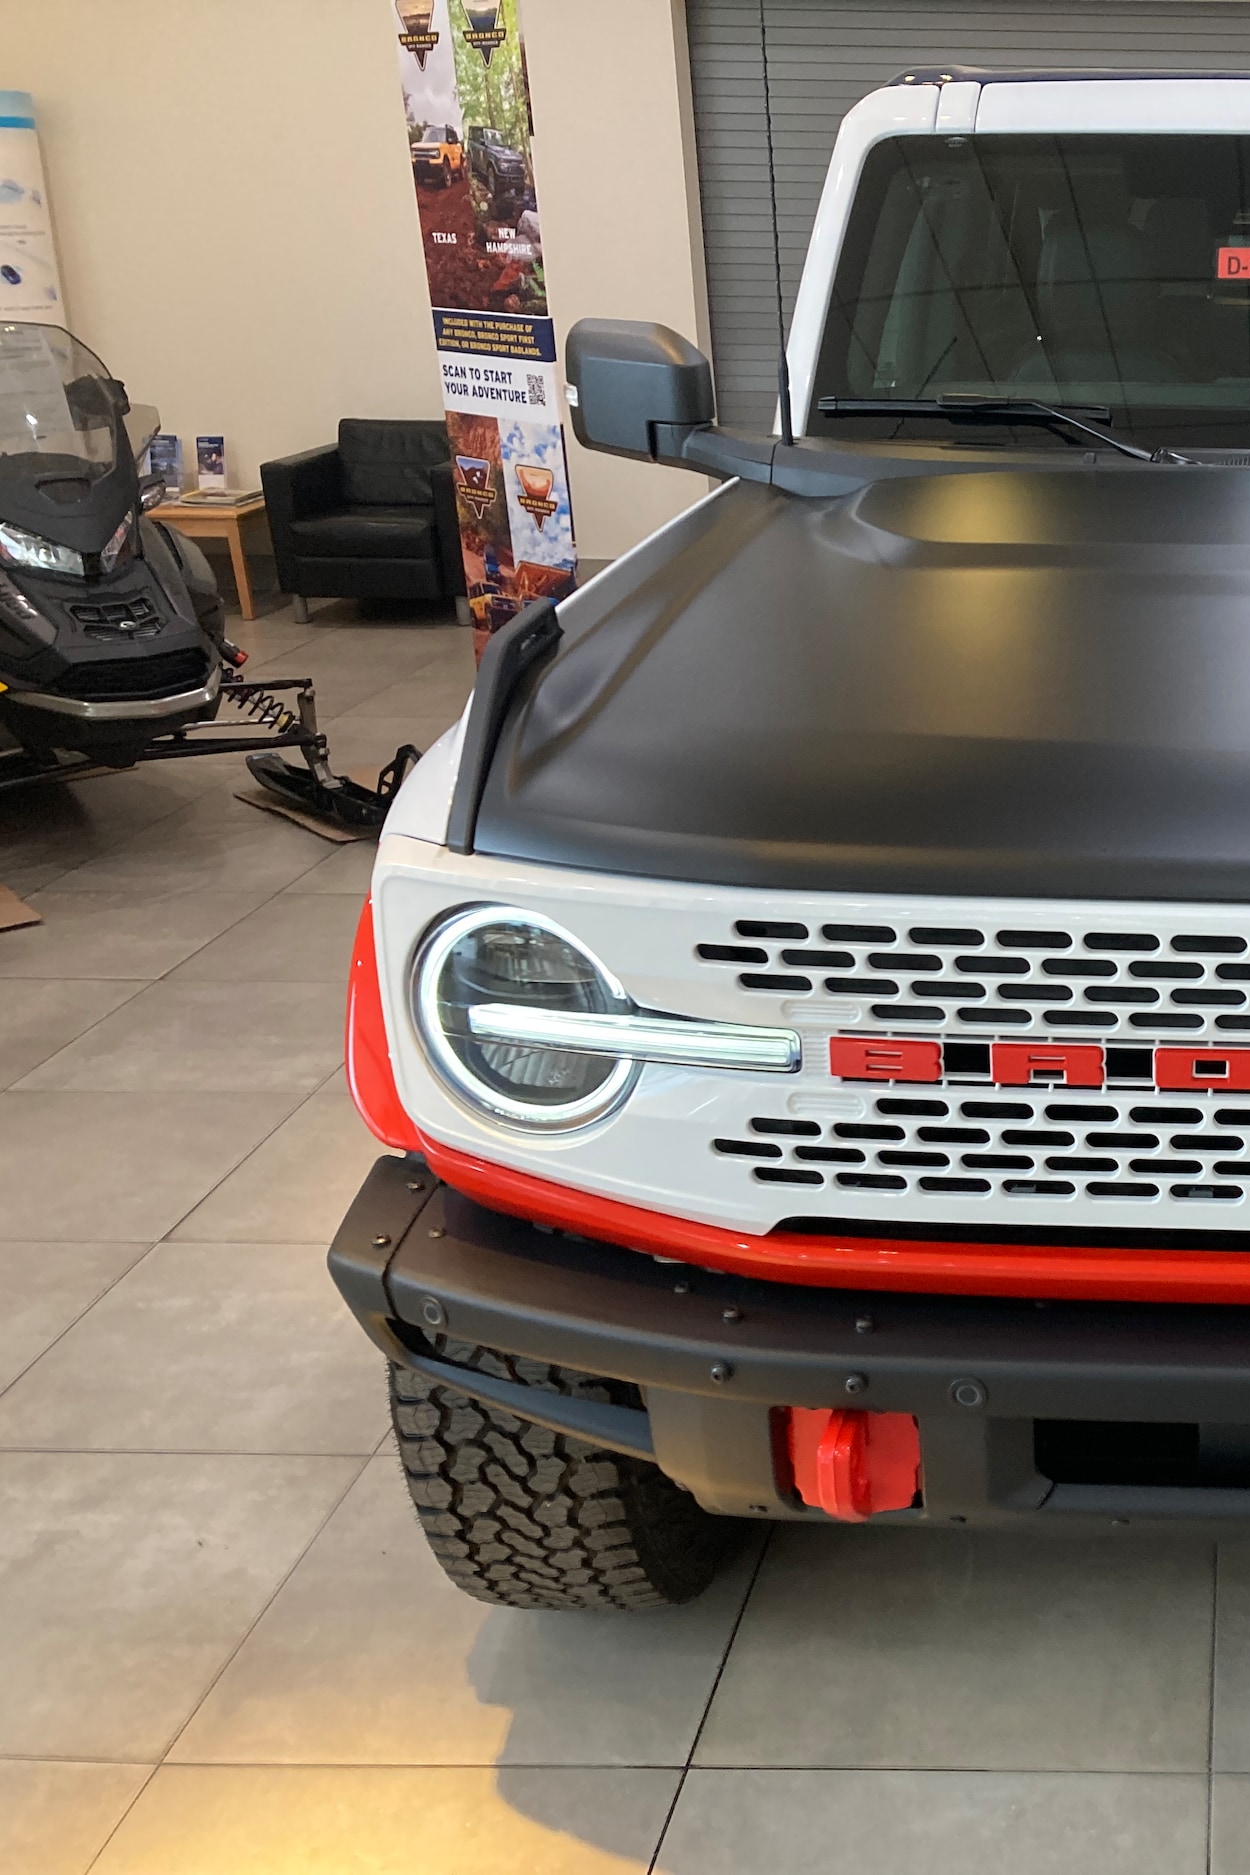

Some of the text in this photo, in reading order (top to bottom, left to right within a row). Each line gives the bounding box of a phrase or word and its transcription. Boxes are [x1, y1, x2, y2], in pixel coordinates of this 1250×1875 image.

[431, 232, 457, 244] TEXAS
[497, 228, 516, 239] NEW
[485, 242, 532, 255] HAMPSHIRE
[495, 322, 524, 333] PURCHASE
[500, 333, 517, 342] SPORT
[518, 336, 535, 344] FIRST
[442, 364, 512, 384] SCAN TO START
[444, 381, 527, 404] YOUR ADVENTURE
